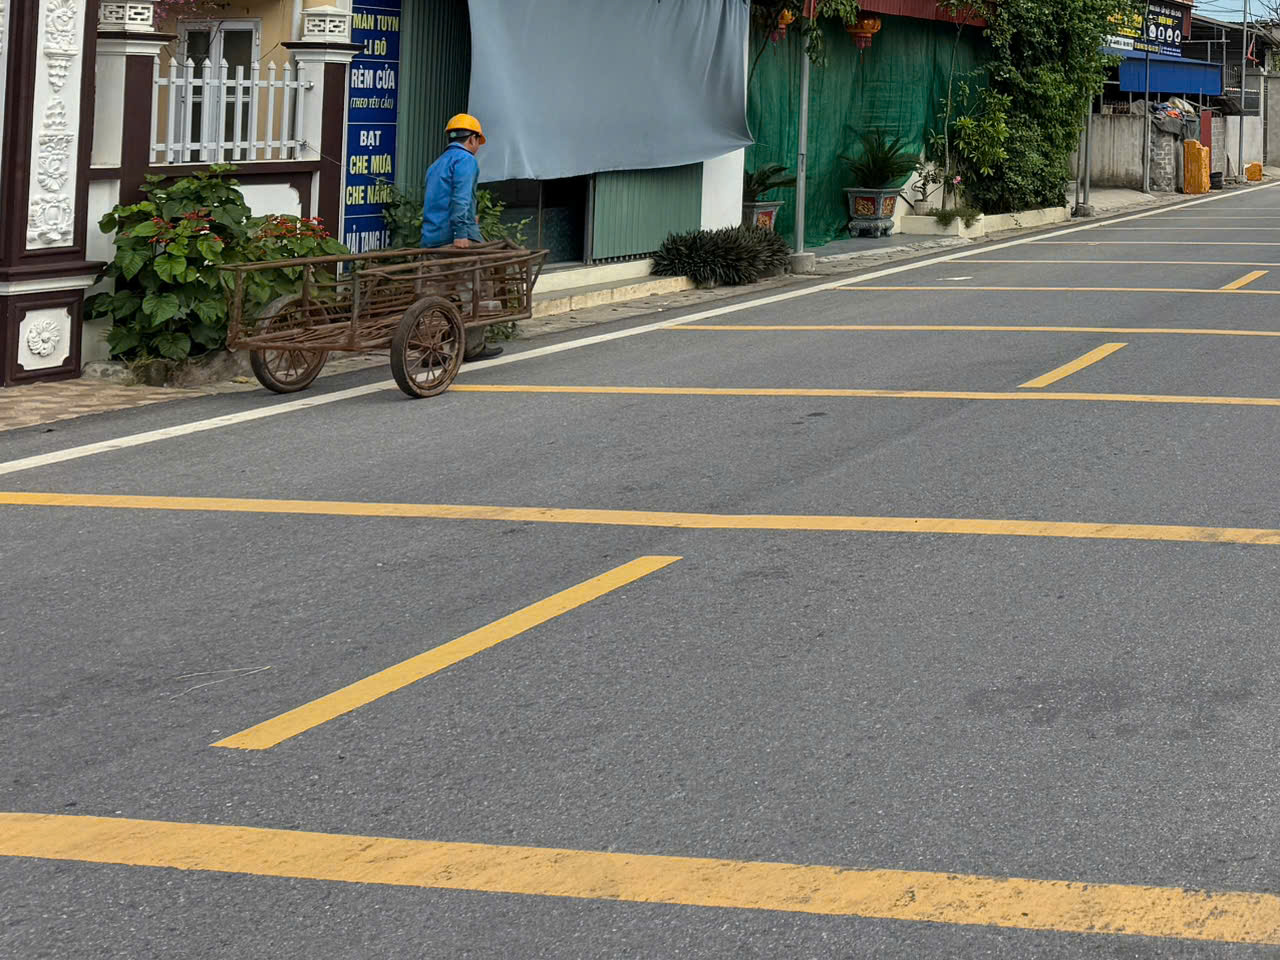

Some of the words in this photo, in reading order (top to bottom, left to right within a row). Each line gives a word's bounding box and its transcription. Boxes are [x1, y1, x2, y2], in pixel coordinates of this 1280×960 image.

[352, 10, 375, 30] MÀN
[376, 15, 399, 32] TUYN
[374, 37, 387, 56] ĐÔ
[351, 64, 374, 89] RÈM
[375, 64, 395, 90] CỬA
[360, 130, 382, 150] BẠT
[349, 155, 369, 175] CHE
[370, 153, 392, 174] MƯA
[346, 185, 365, 206] CHE
